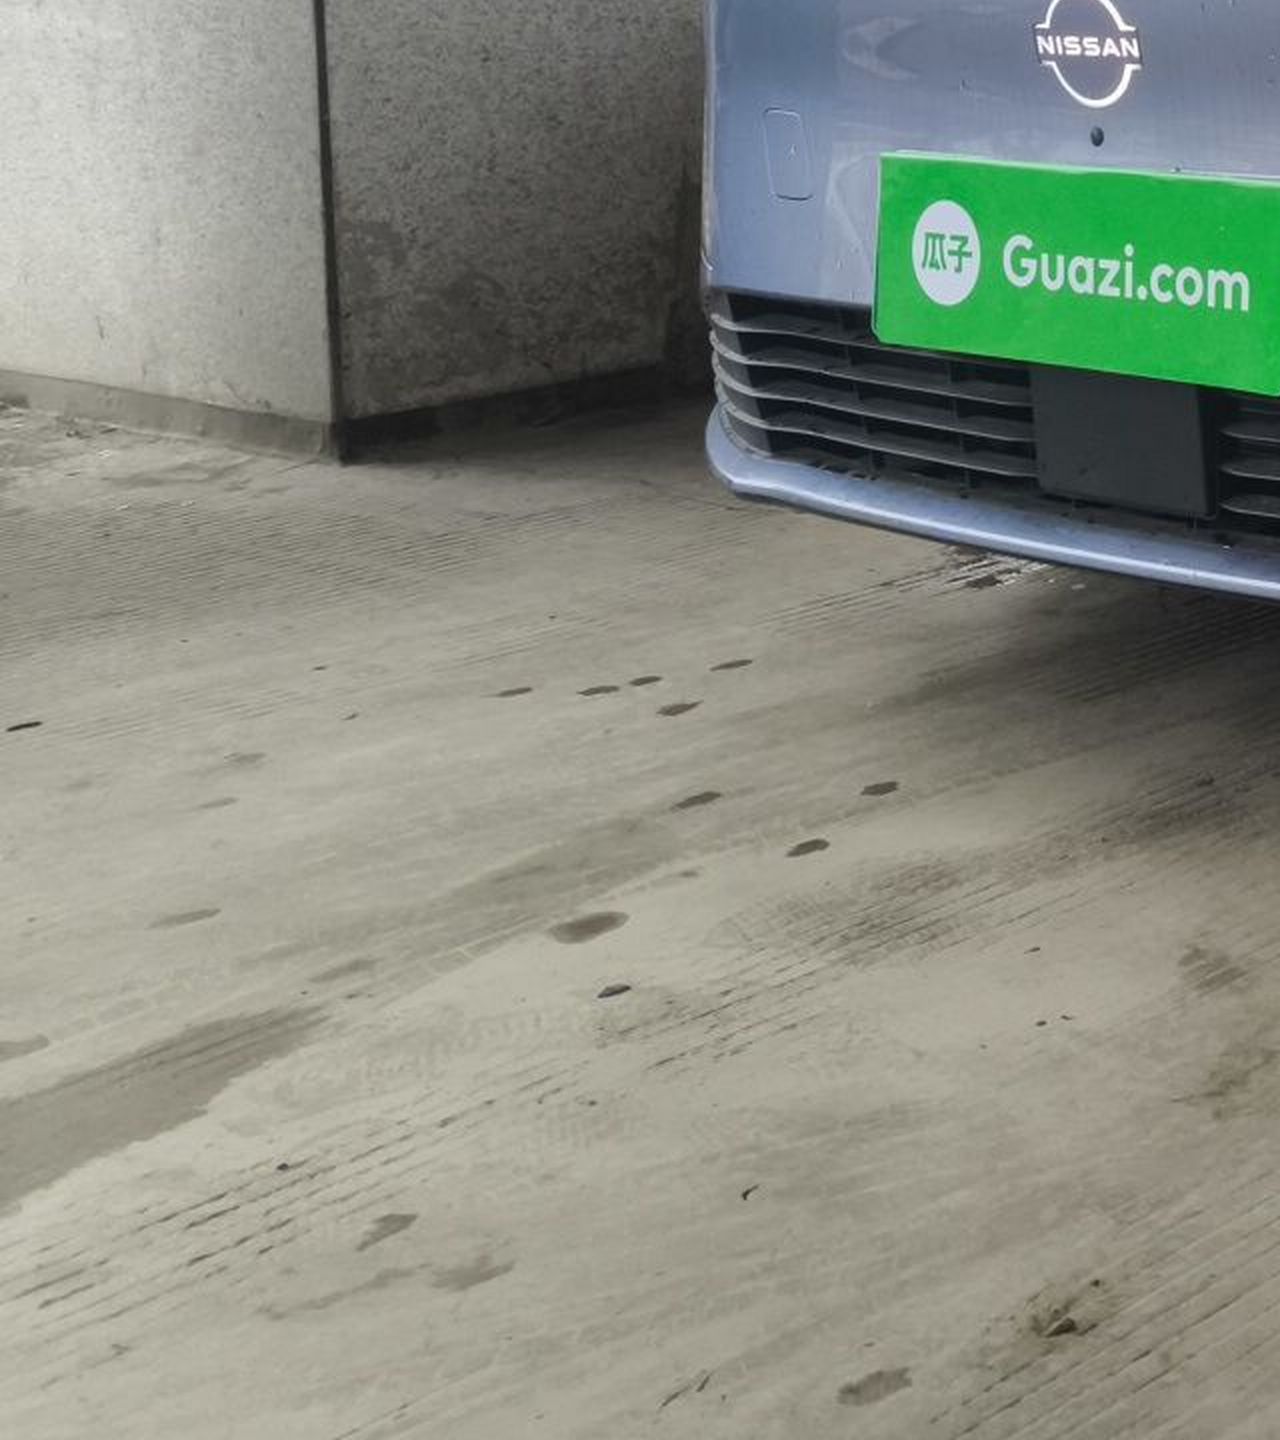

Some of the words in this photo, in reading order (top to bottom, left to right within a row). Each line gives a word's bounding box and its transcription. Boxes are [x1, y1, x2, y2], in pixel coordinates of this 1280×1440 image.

[1036, 35, 1140, 58] NISSAN
[922, 232, 972, 273] 瓜子
[1002, 234, 1249, 311] Guazi.com
